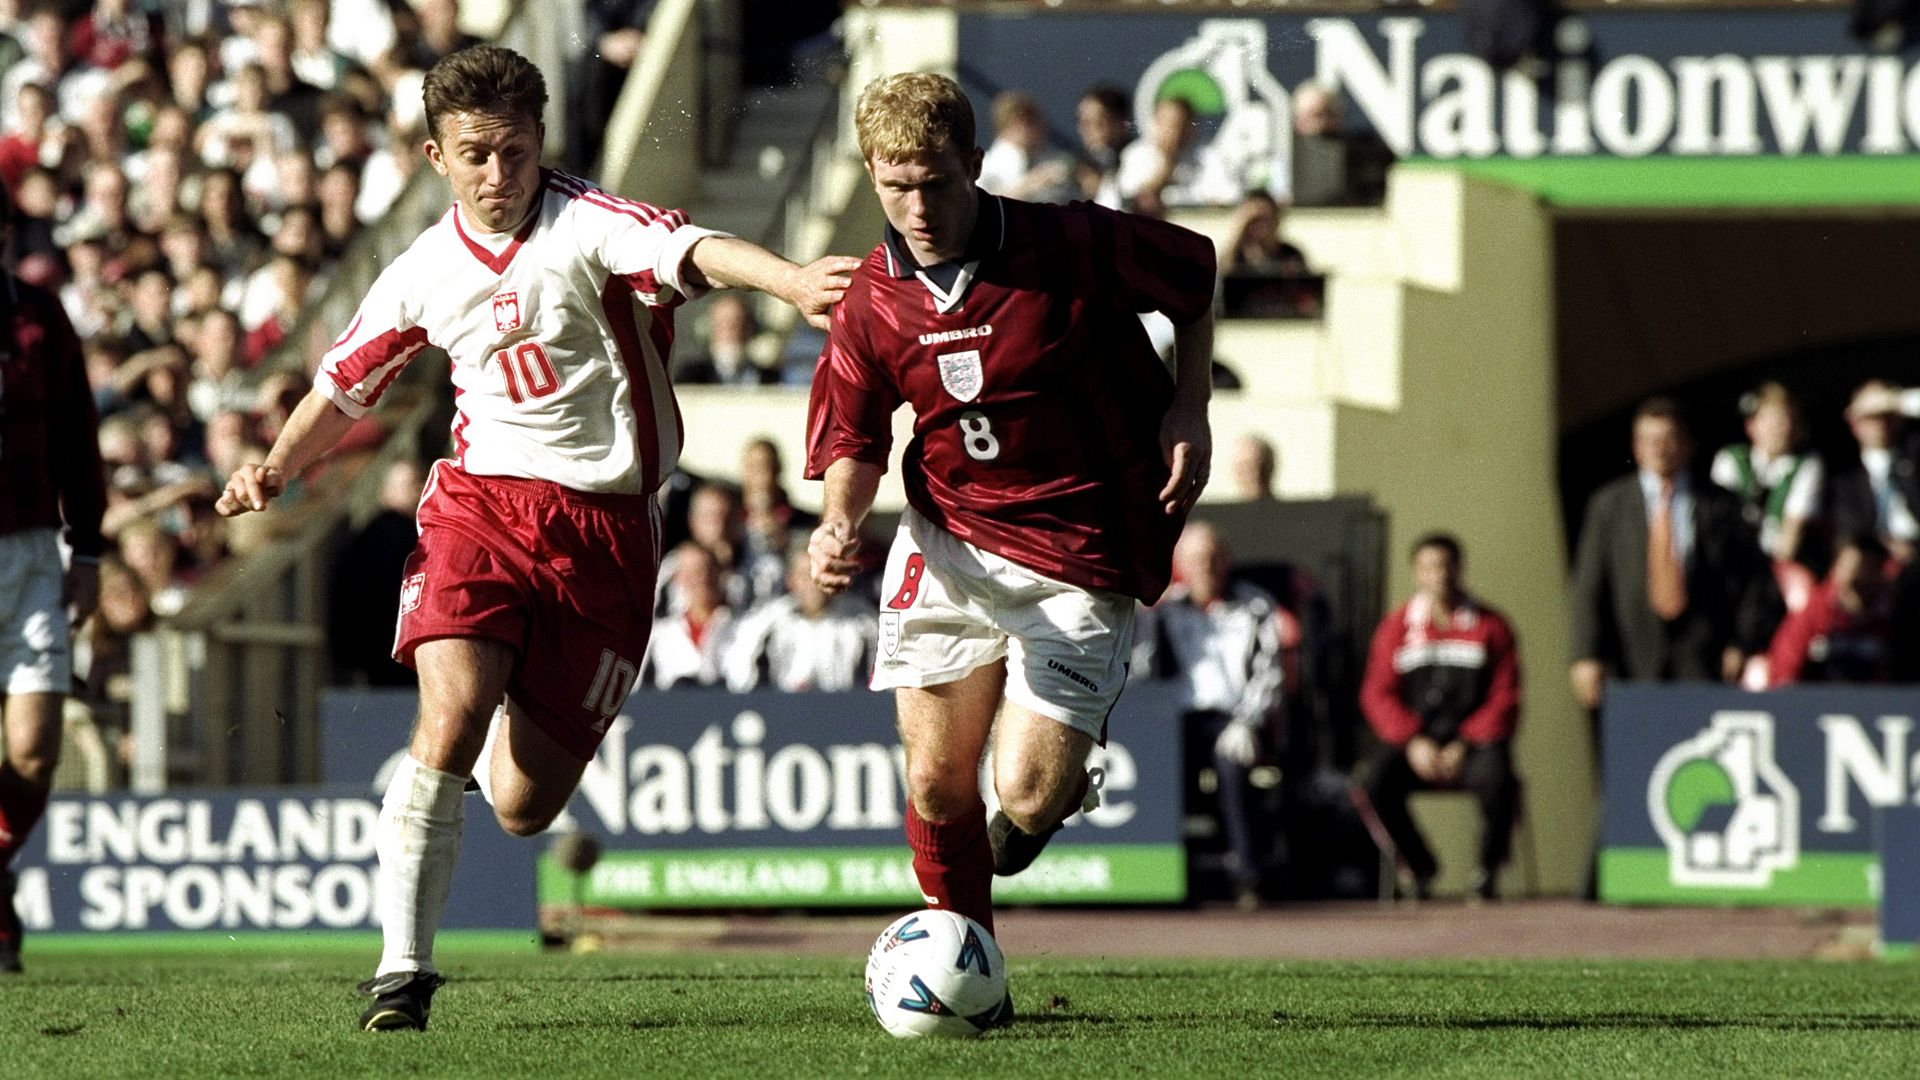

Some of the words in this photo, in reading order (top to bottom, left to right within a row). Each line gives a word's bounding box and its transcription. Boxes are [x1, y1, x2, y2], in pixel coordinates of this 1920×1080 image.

[919, 324, 993, 346] UMBRO
[496, 341, 560, 404] 10
[960, 411, 999, 460] 8
[887, 552, 925, 610] 8
[582, 648, 637, 718] 10
[1047, 659, 1099, 693] UMBRO
[46, 798, 381, 863] ENGLAND
[664, 859, 832, 897] ENGLAND
